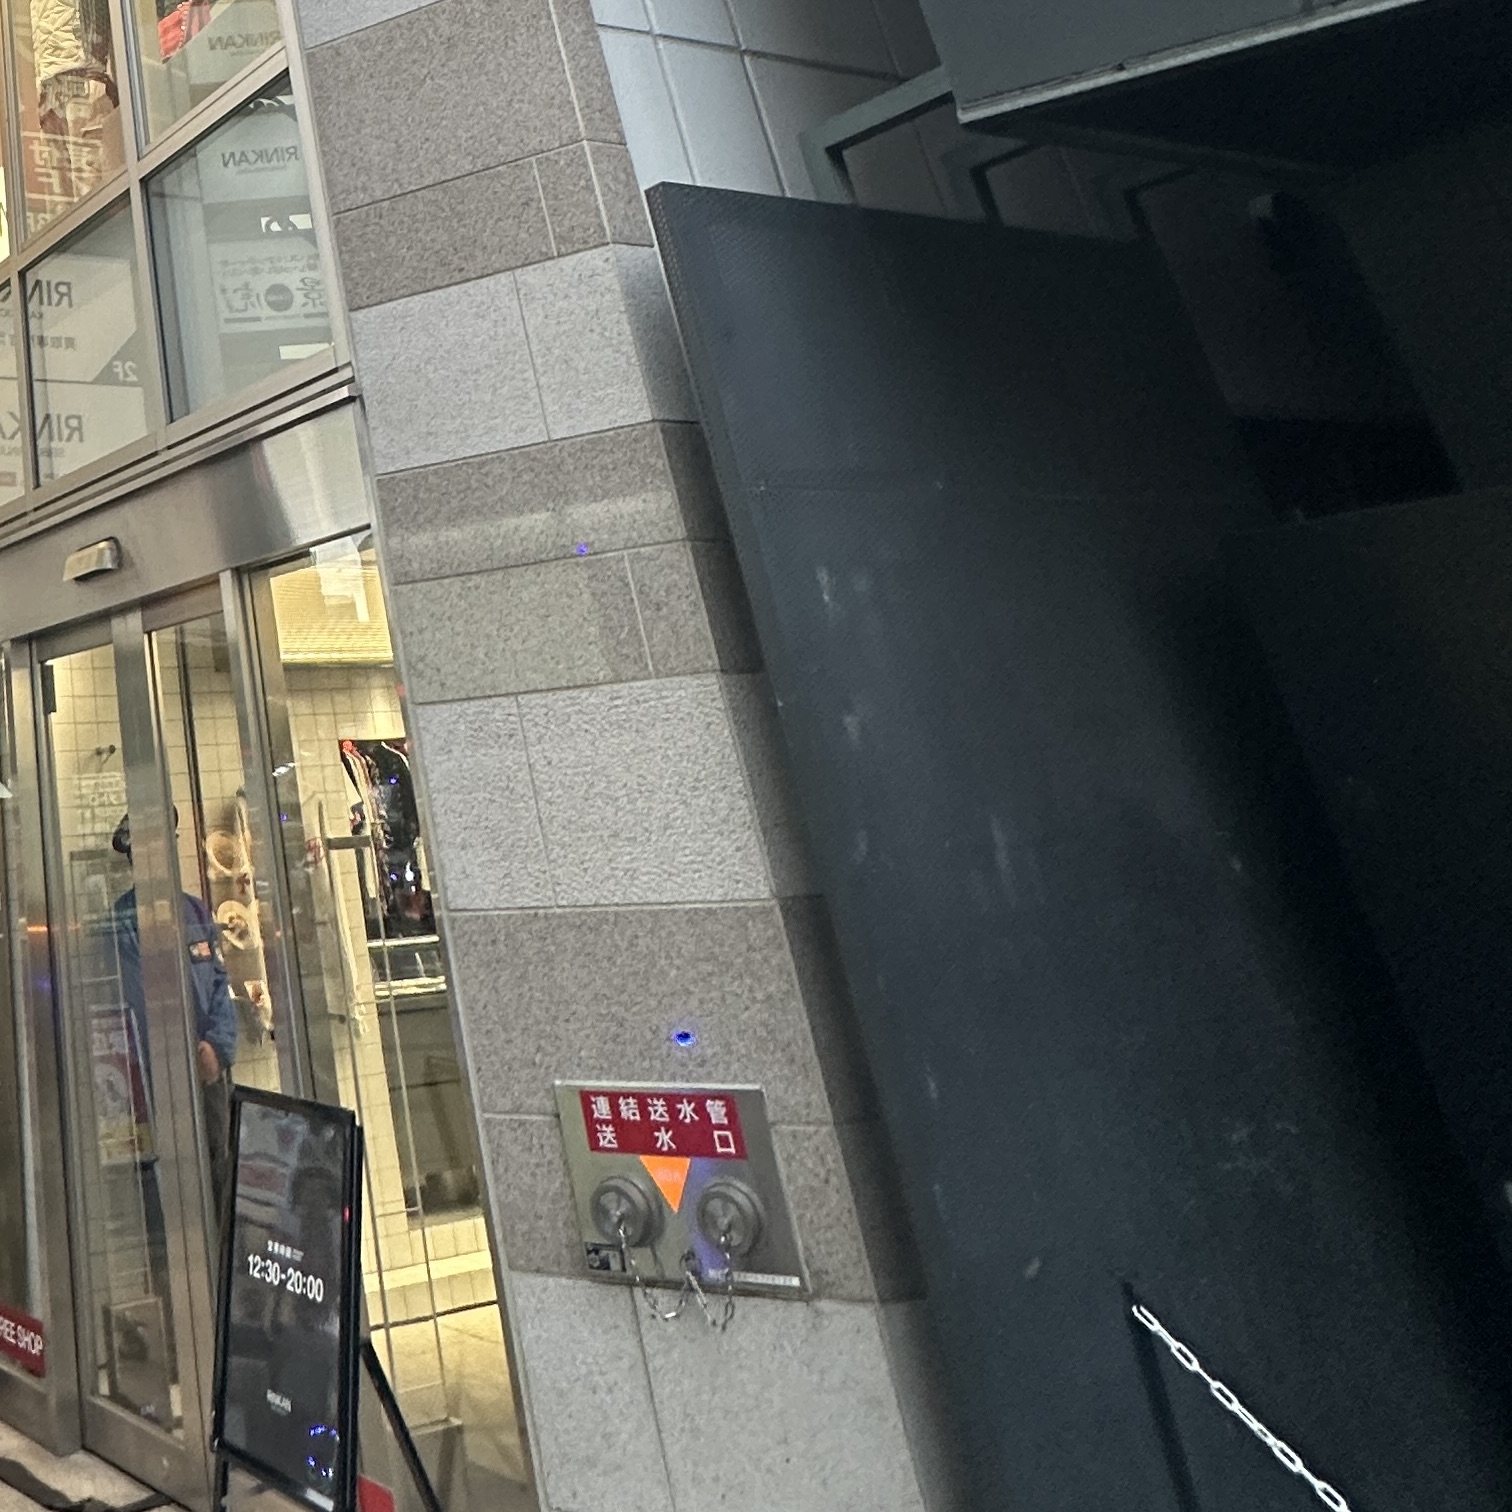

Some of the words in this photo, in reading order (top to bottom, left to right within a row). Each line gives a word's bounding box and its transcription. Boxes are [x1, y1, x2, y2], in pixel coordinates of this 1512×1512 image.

[589, 1095, 729, 1126] 連結送水管
[247, 1252, 324, 1303] 12:30-20:00
